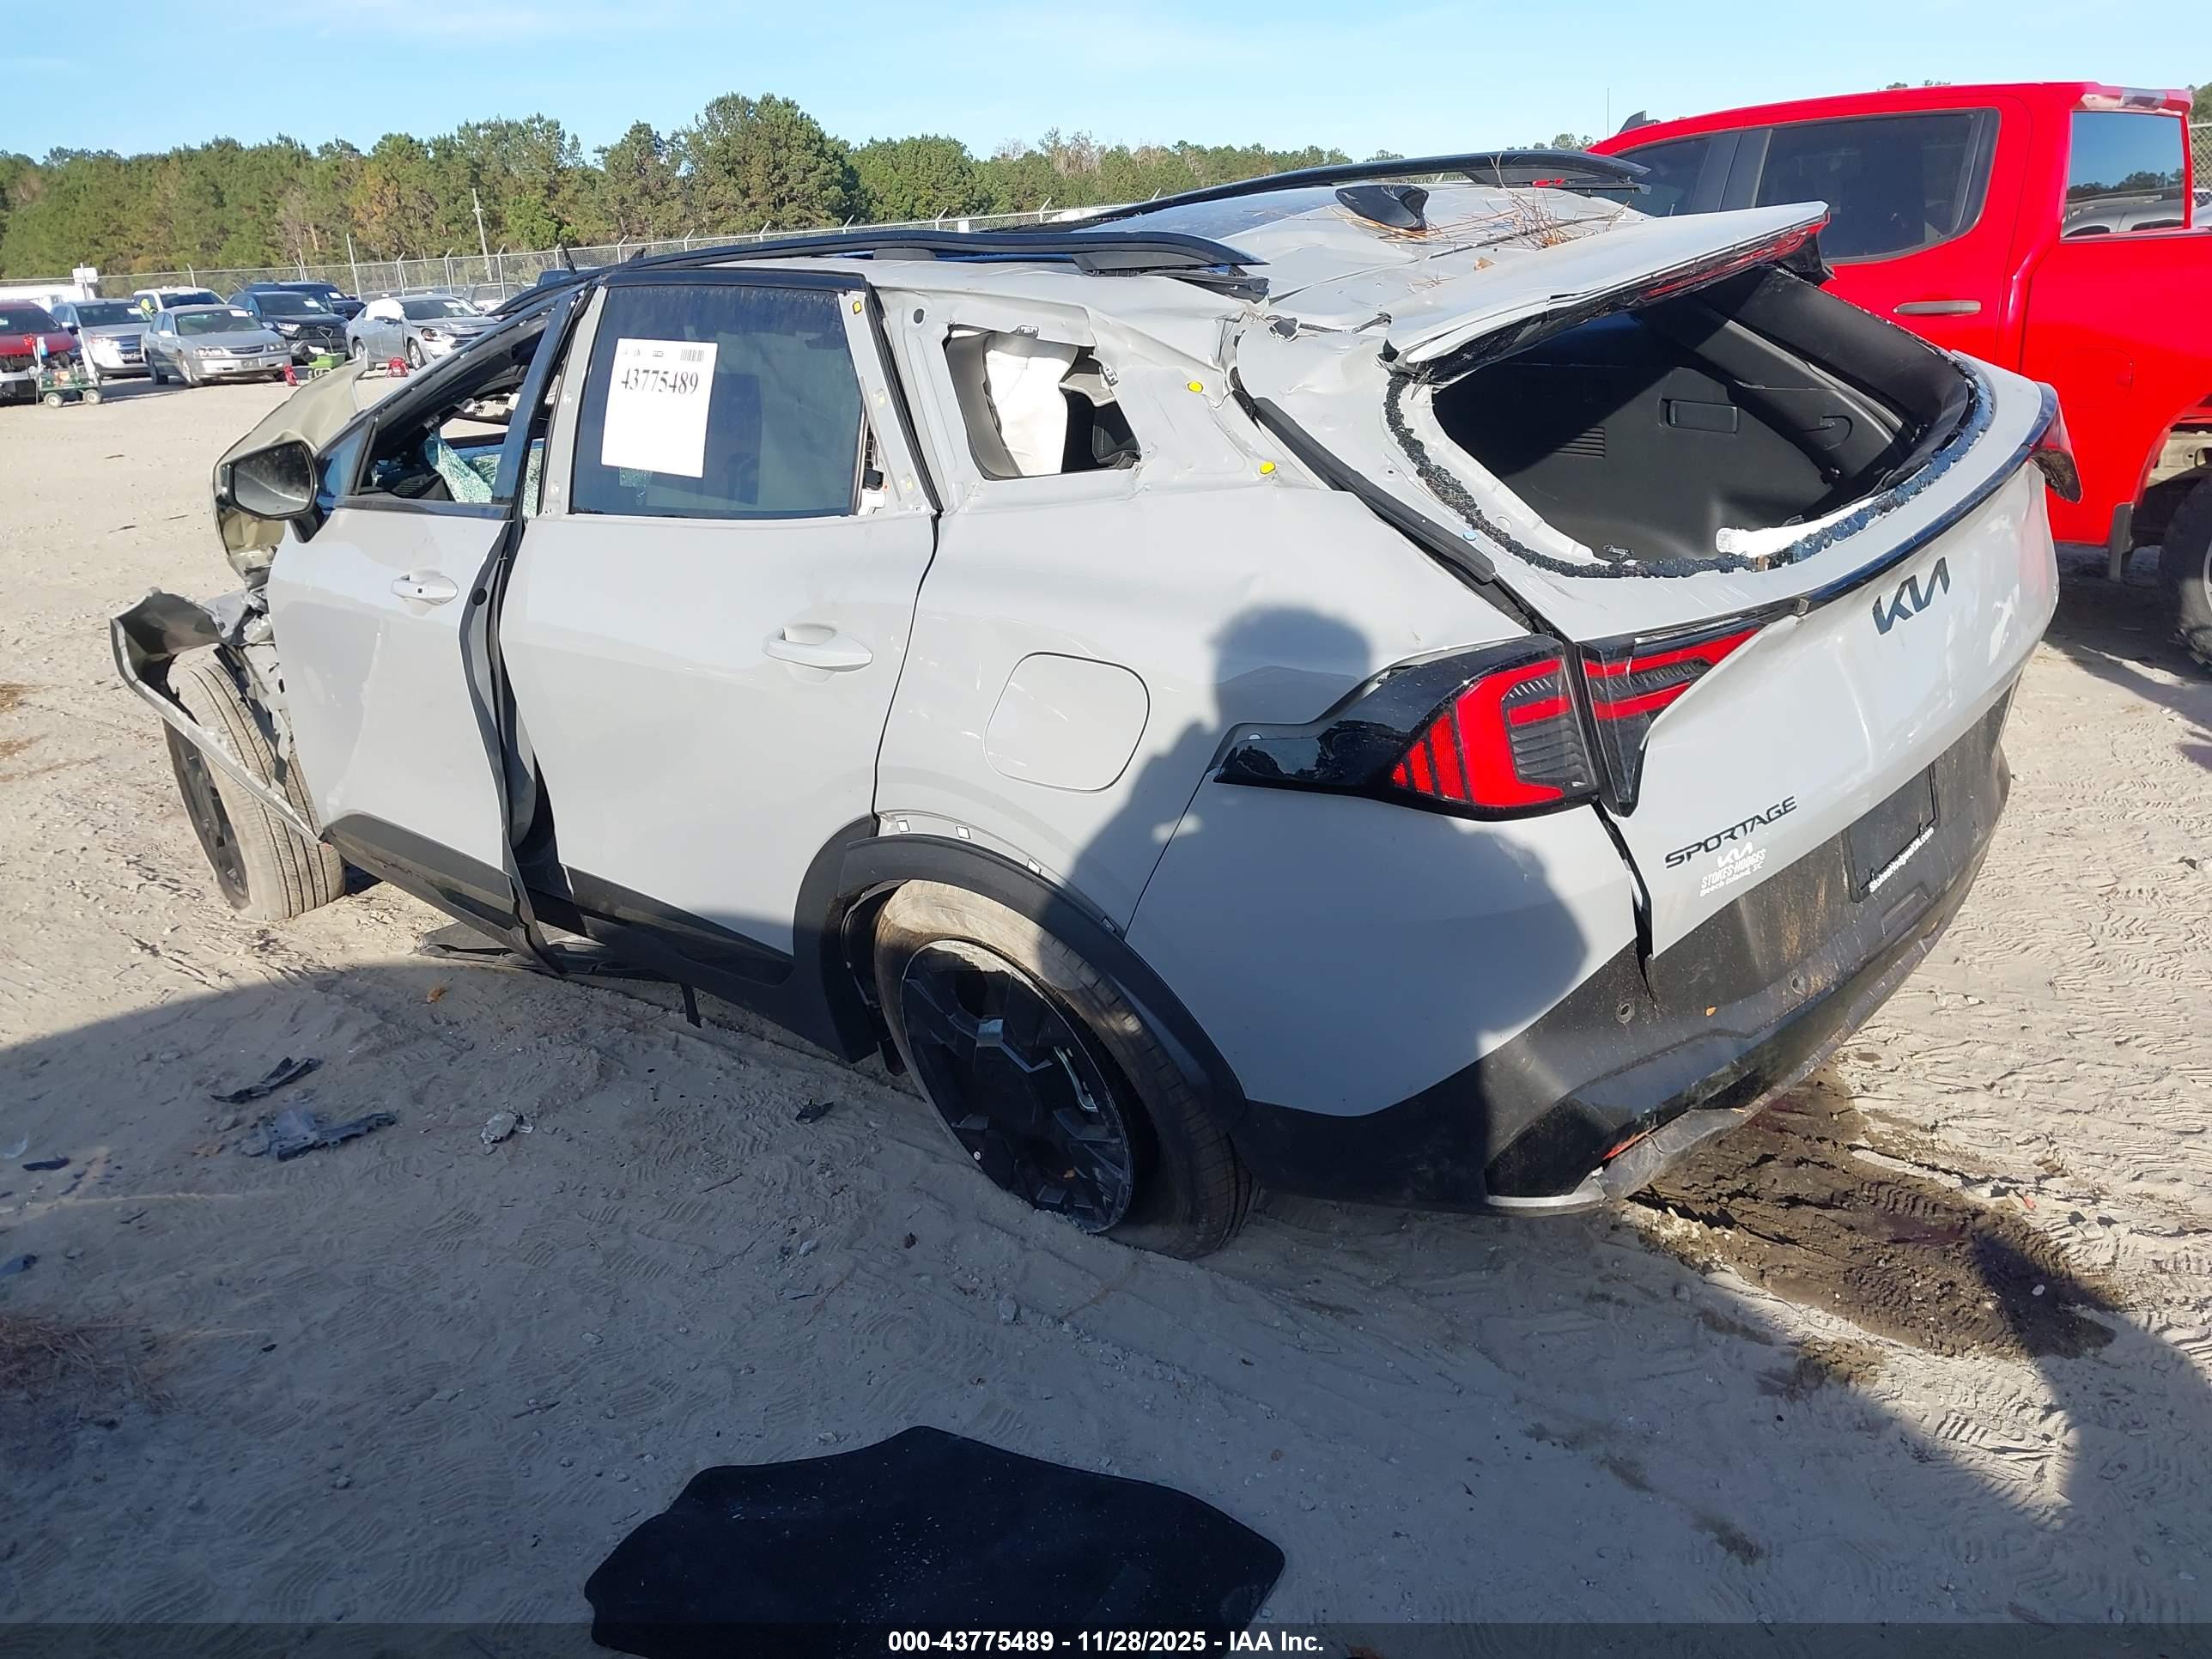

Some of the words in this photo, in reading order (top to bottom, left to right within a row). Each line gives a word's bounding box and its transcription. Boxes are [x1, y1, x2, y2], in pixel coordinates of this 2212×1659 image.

[621, 368, 698, 395] 43775489
[1872, 556, 1950, 635] KIA
[1665, 796, 1797, 868] SPORTAGE
